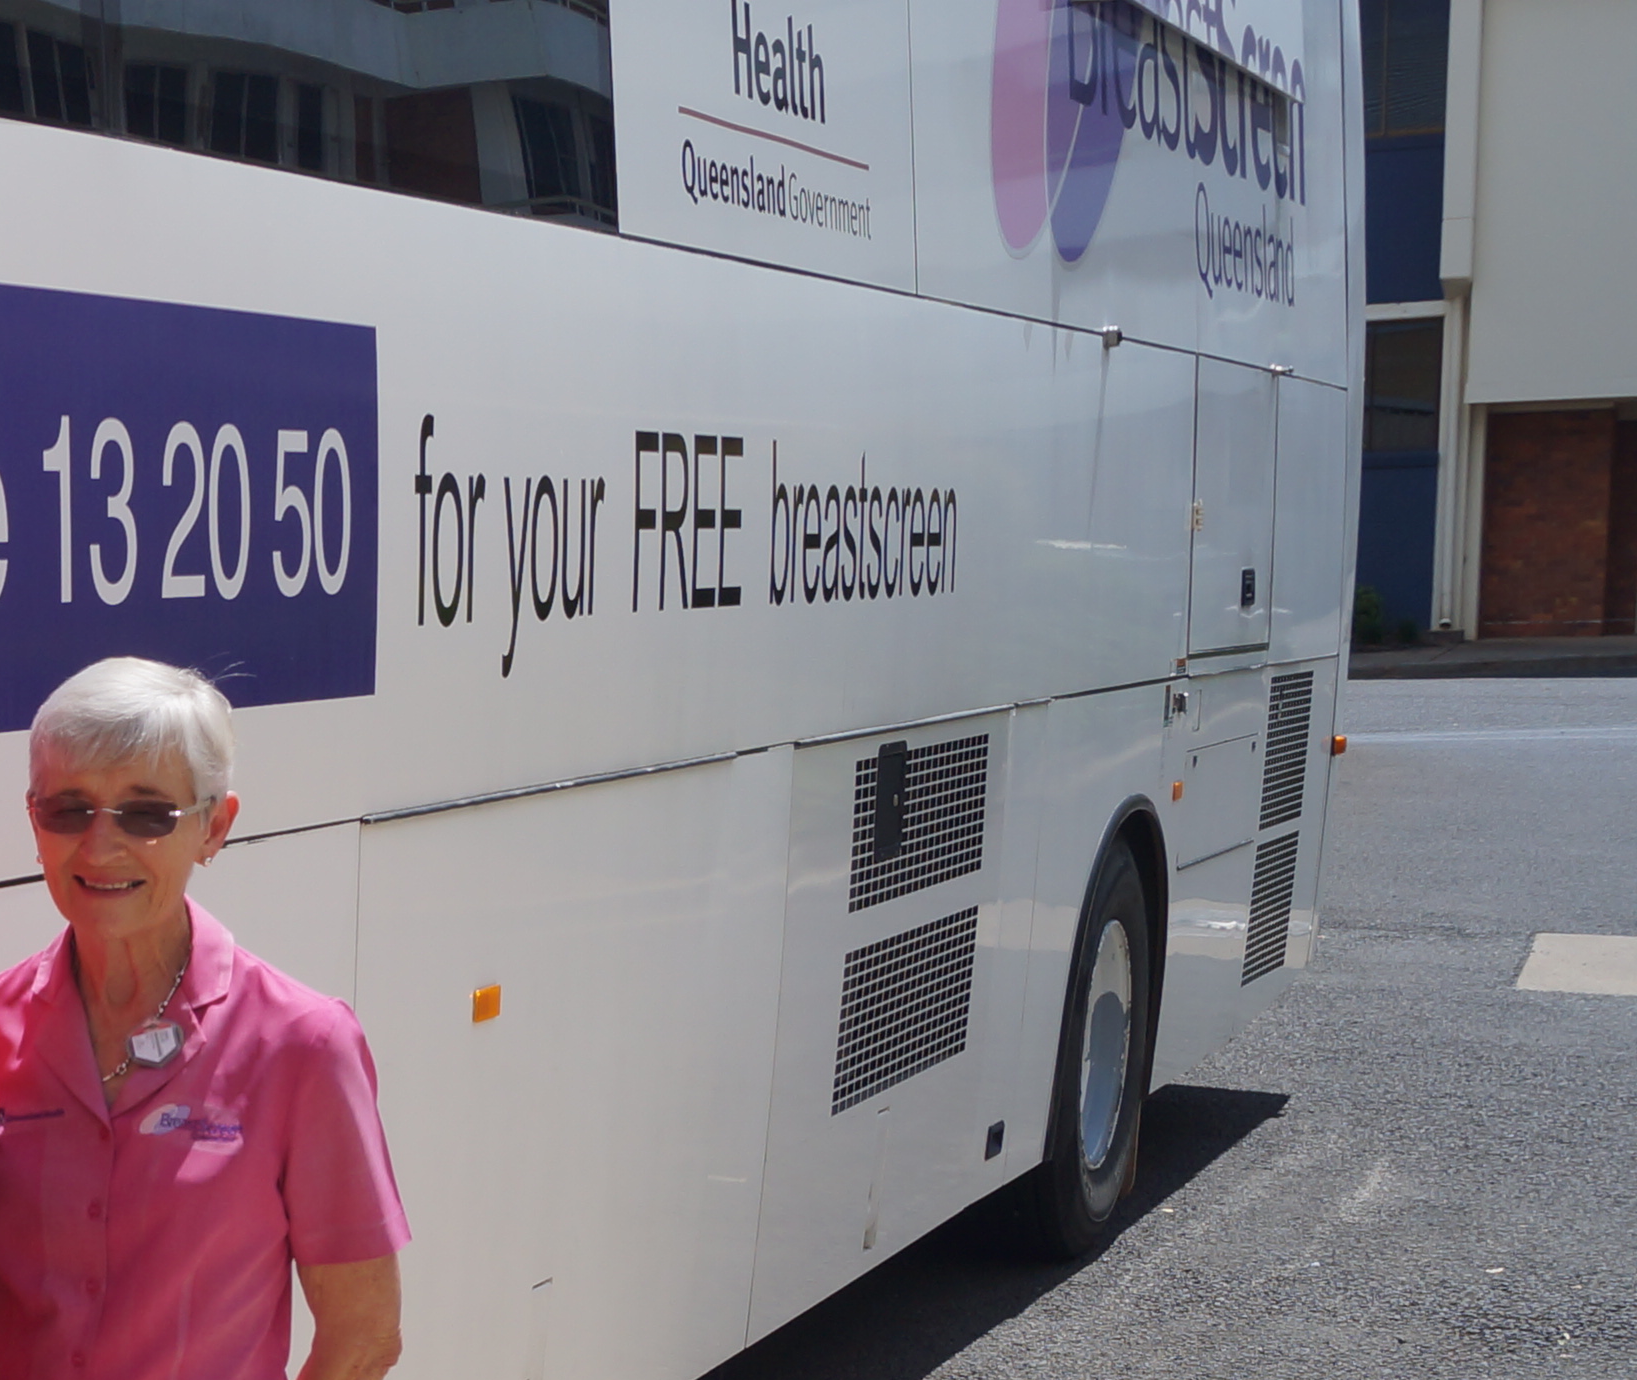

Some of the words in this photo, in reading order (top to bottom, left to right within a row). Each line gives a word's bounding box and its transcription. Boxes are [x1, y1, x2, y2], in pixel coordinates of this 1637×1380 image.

[731, 0, 826, 124] Health
[1195, 182, 1295, 308] Queensland
[43, 415, 138, 606] 13
[161, 421, 250, 600] 20
[272, 427, 352, 598] 50
[415, 413, 486, 627] for
[501, 473, 605, 679] your
[632, 430, 744, 612] FREE
[769, 439, 958, 606] breastscreen
